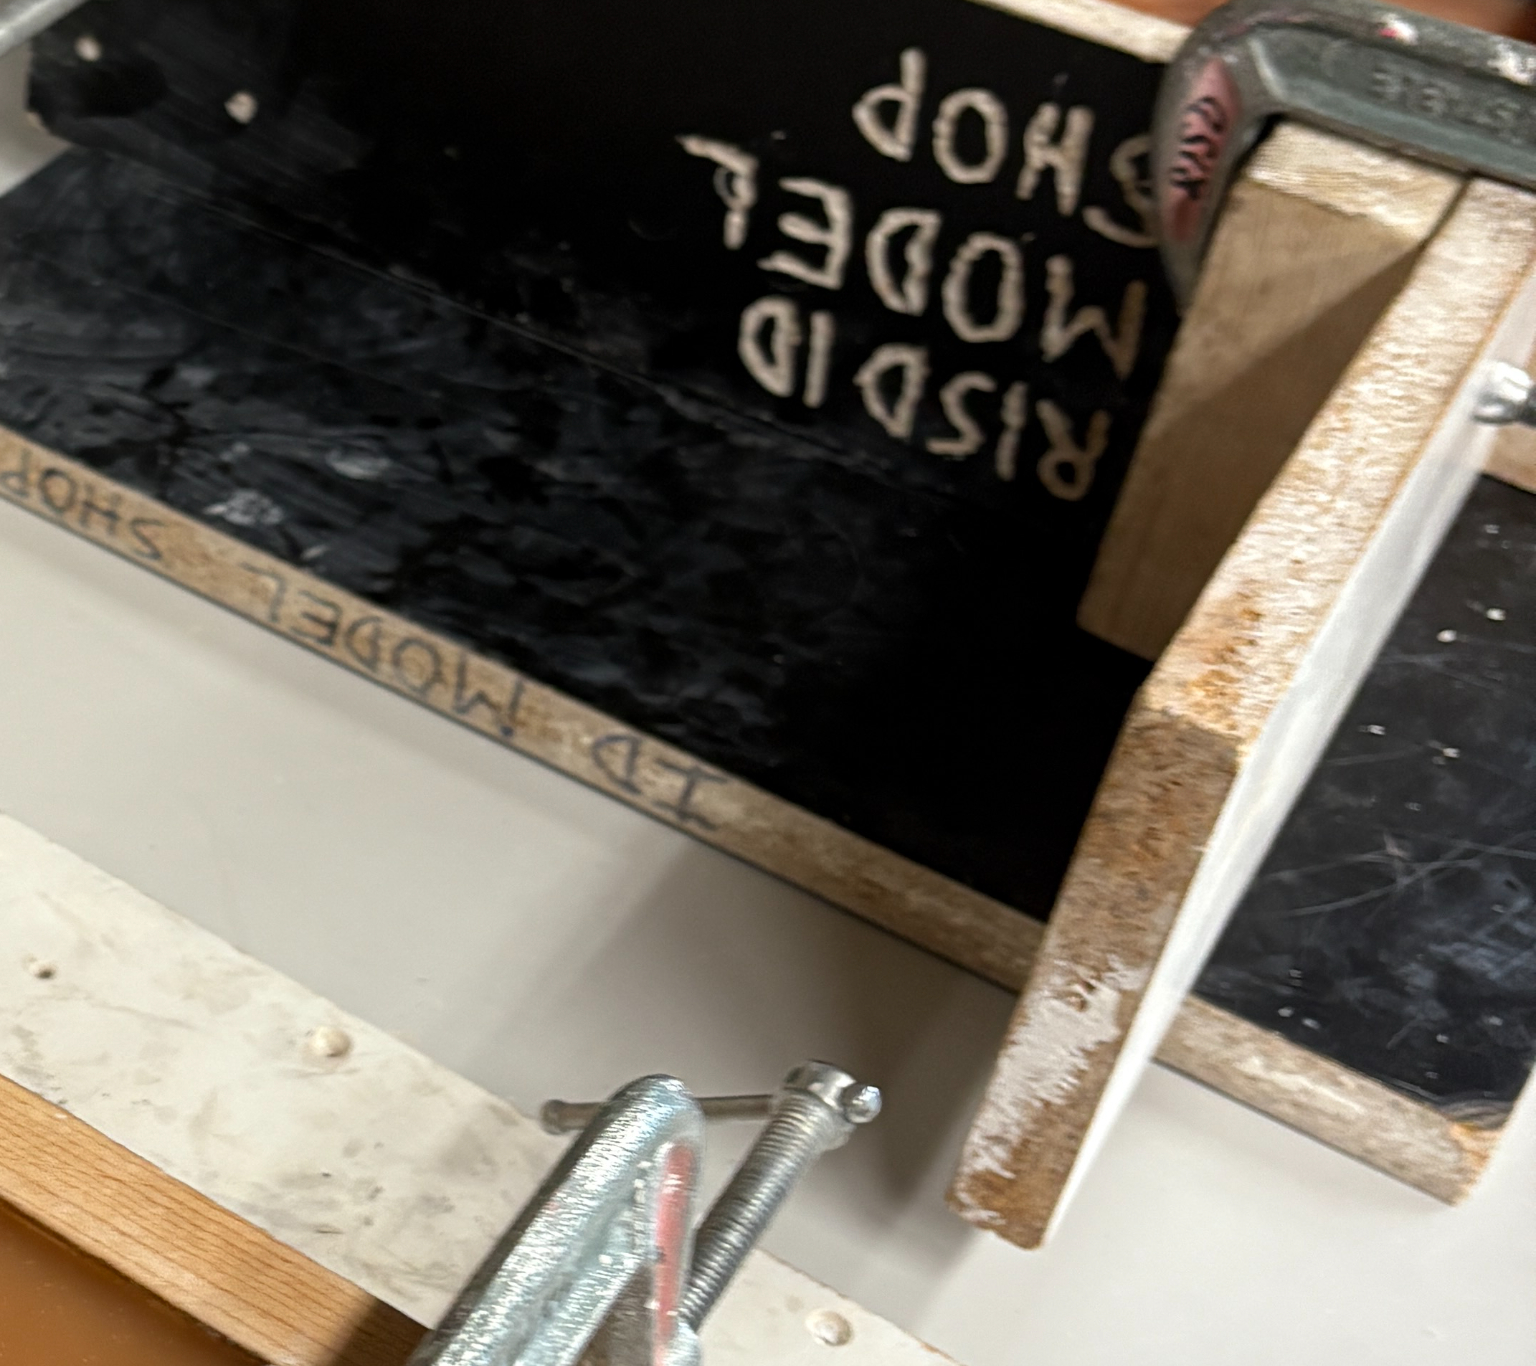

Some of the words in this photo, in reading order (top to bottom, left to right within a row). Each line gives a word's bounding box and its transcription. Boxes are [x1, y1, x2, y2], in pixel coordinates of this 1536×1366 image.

[851, 47, 1161, 249] SHOP
[674, 134, 1148, 380] MODEL
[240, 560, 527, 740] MODEL
[590, 733, 730, 832] ID
